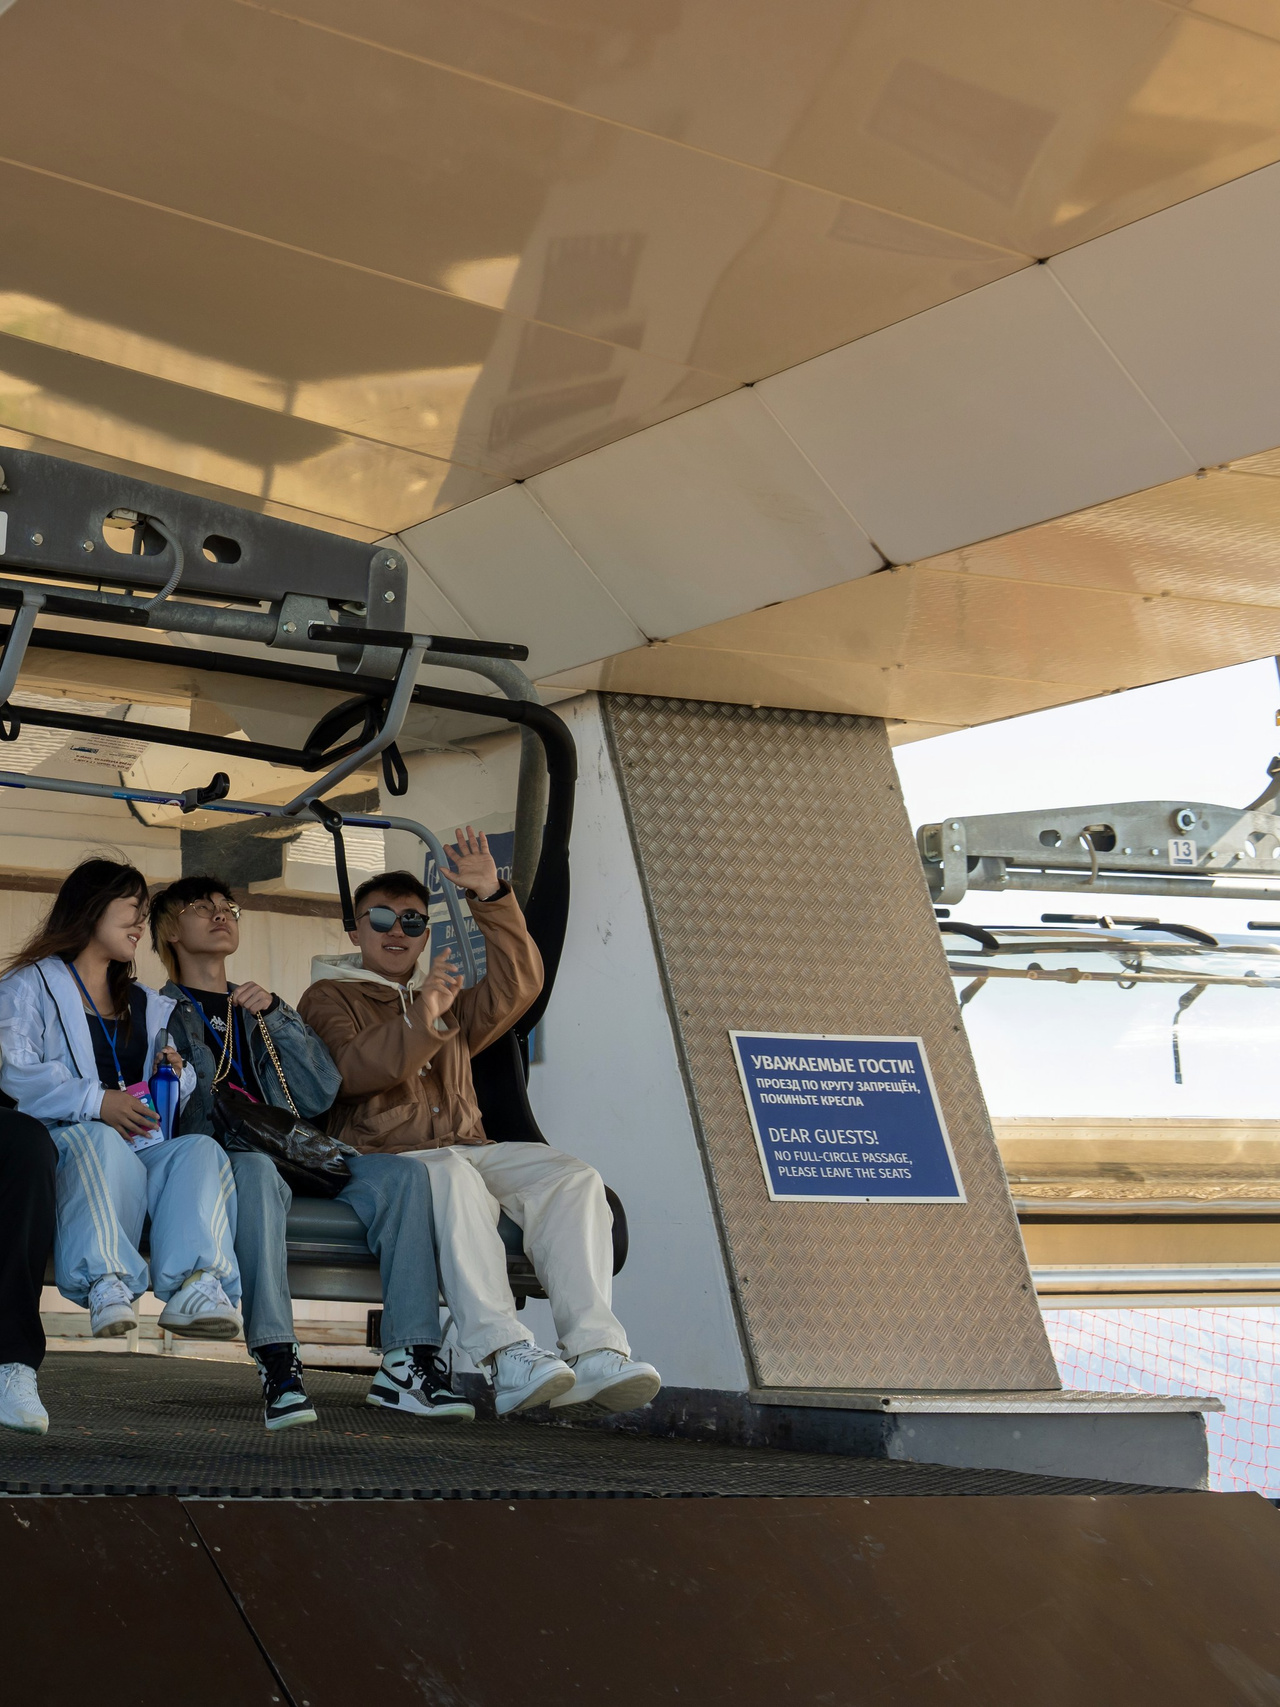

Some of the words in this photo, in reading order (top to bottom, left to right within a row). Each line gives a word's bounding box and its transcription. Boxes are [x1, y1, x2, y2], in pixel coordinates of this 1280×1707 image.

[1173, 841, 1192, 857] 13
[751, 1054, 856, 1073] УВАЖАЕМЫЕ
[858, 1058, 916, 1074] ГОСТИ!
[756, 1077, 801, 1091] ПРОЕЗД
[801, 1079, 818, 1090] ПО
[820, 1080, 854, 1091] КРУГУ
[856, 1079, 921, 1094] ЗАПРЕЩЁН,
[759, 1093, 819, 1105] ПОКИНЬТЕ
[821, 1095, 864, 1106] КРЕСЛА
[768, 1127, 811, 1143] DEAR
[814, 1129, 880, 1145] GUESTS!
[774, 1150, 791, 1161] NO
[793, 1151, 860, 1163] FULL-CIRCLE
[862, 1153, 913, 1165] PASSAGE,
[778, 1166, 818, 1177] PLEASE
[820, 1167, 853, 1178] LEAVE
[854, 1167, 877, 1179] THE
[878, 1168, 912, 1179] SEATS
